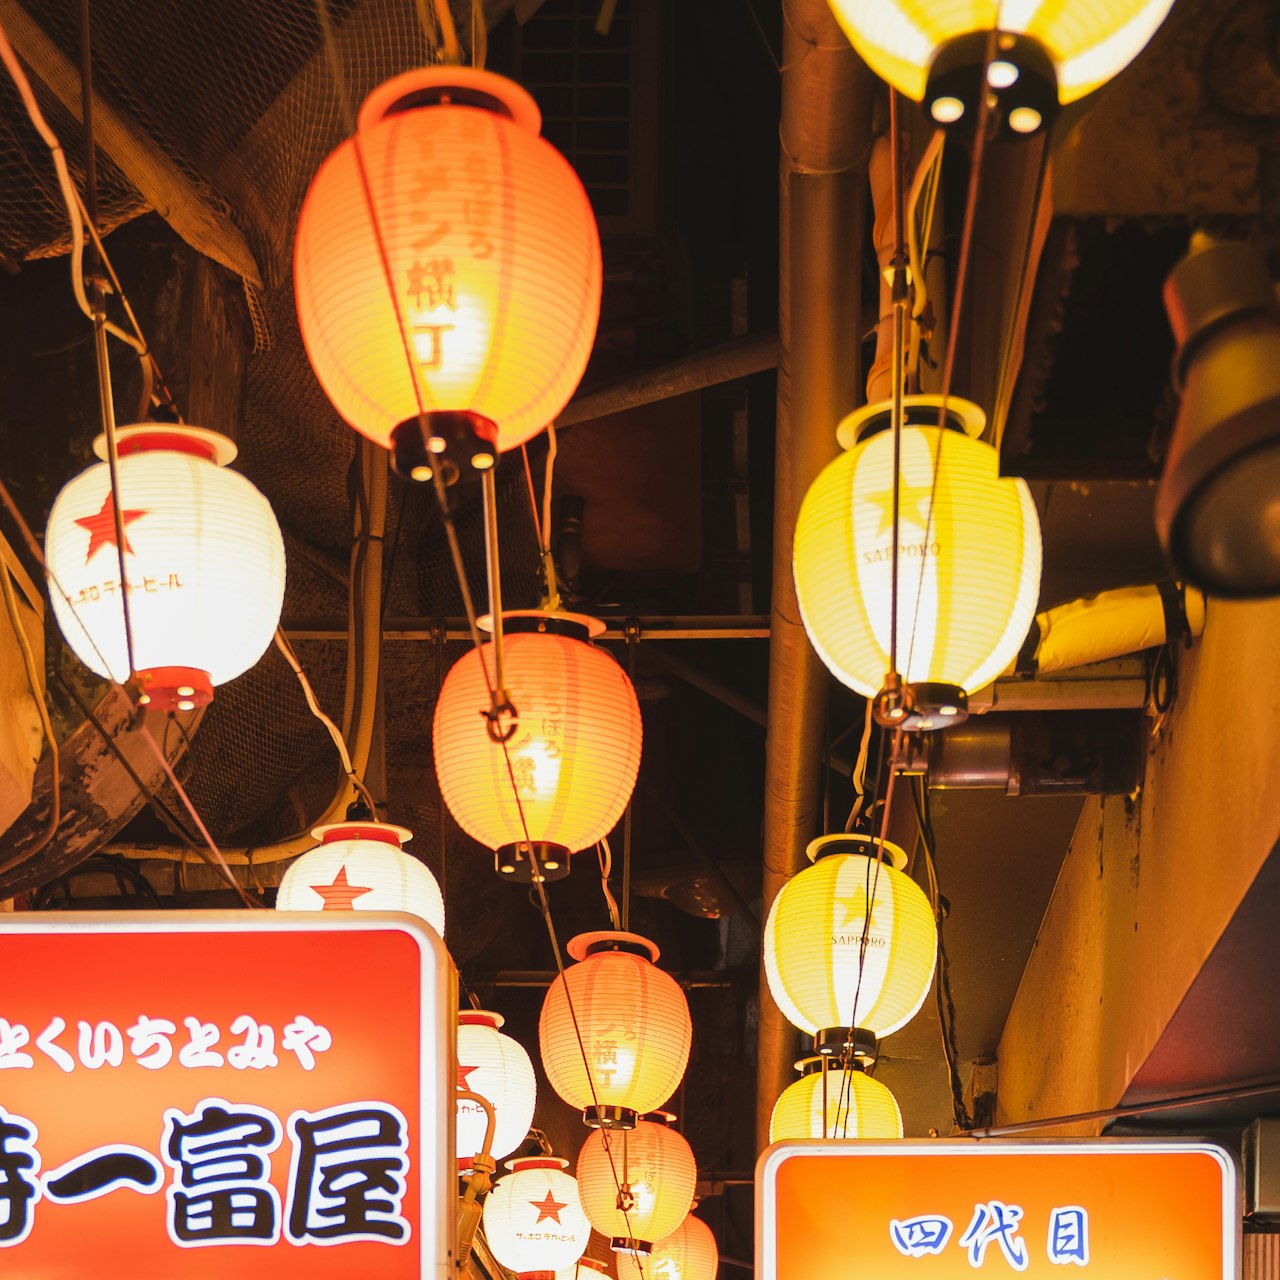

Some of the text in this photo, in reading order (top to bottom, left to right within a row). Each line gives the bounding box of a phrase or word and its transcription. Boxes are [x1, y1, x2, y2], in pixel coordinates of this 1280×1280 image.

[863, 542, 942, 565] SAPPORO
[831, 933, 887, 949] SAPPORO
[892, 1201, 1089, 1272] 四代目
